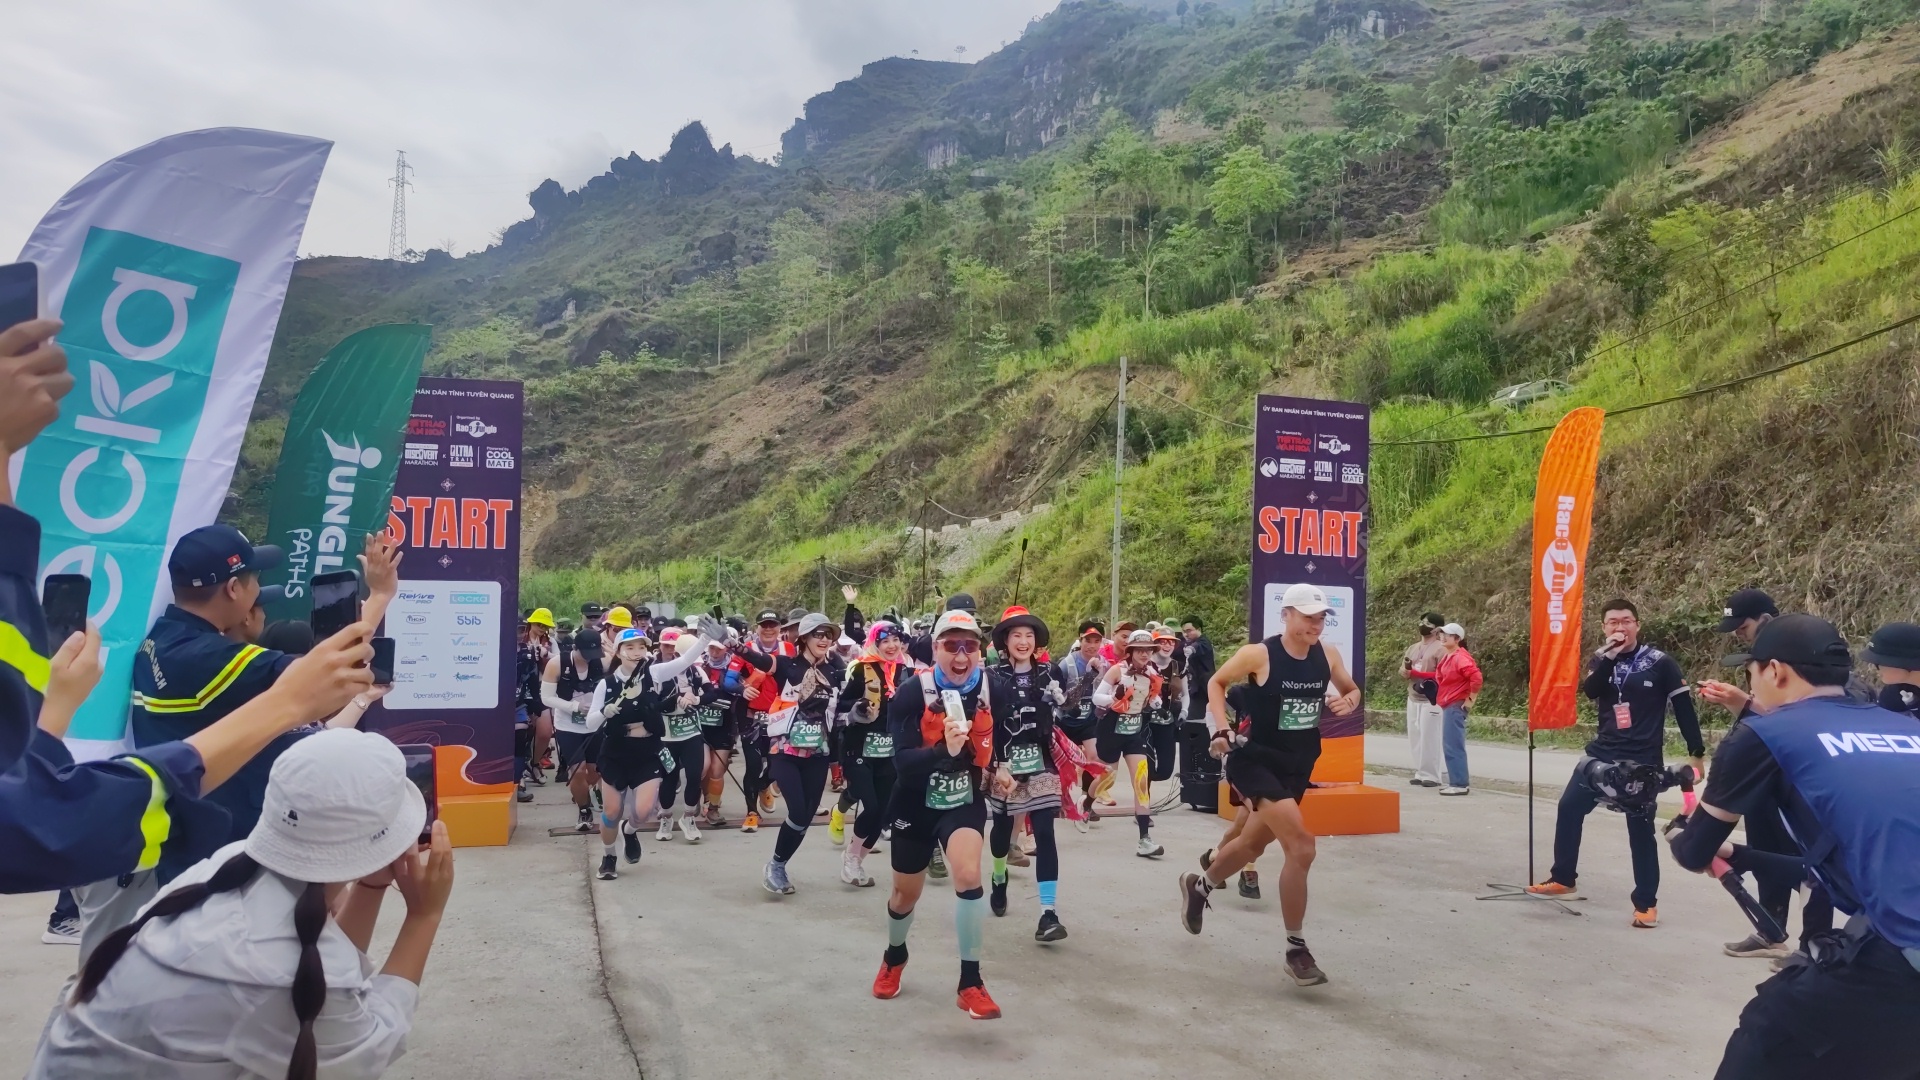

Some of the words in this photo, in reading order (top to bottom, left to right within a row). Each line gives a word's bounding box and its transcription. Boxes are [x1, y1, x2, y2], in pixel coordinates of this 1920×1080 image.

[490, 392, 515, 400] QUANG
[486, 451, 515, 460] COOL
[487, 460, 513, 468] MATE
[39, 266, 198, 688] ecka
[1341, 467, 1364, 476] COOL
[1342, 475, 1364, 483] MATE
[382, 495, 514, 549] START
[1258, 505, 1363, 558] START
[284, 528, 313, 599] PATHS
[703, 708, 722, 718] 2155
[1291, 701, 1320, 714] 2261
[1123, 716, 1141, 725] 2401
[1012, 746, 1039, 760] 2235
[938, 775, 969, 792] 2163
